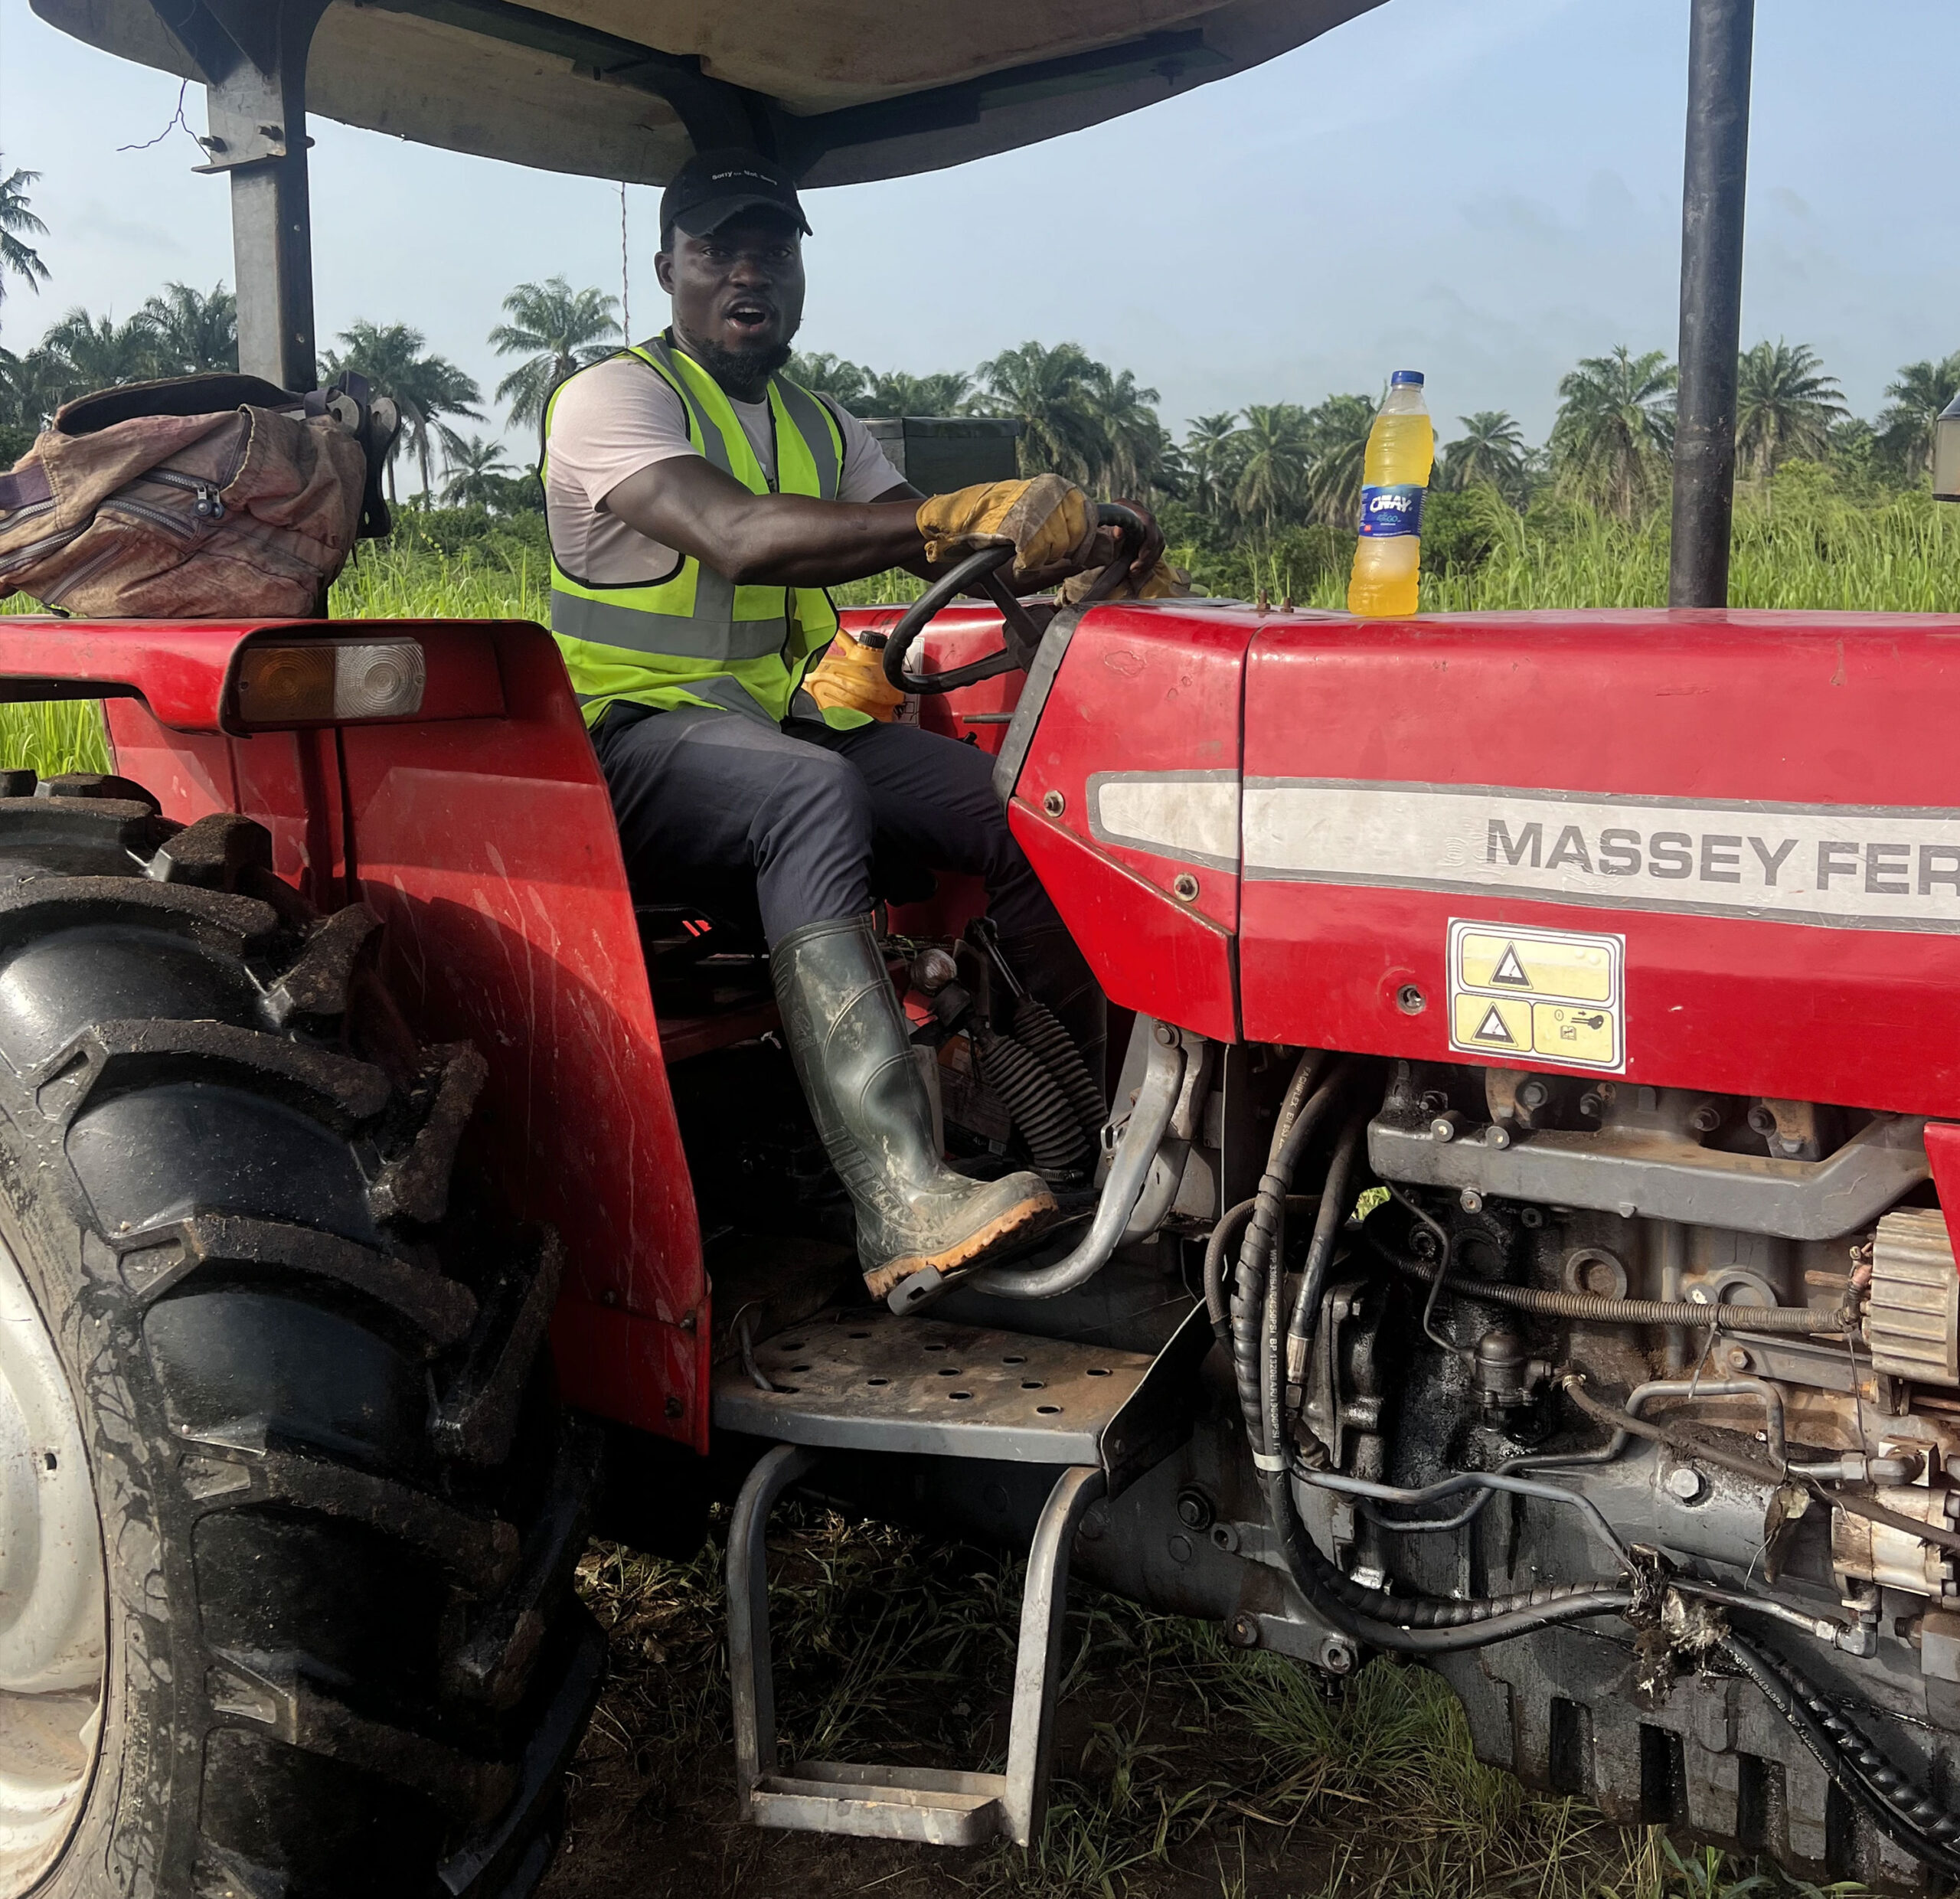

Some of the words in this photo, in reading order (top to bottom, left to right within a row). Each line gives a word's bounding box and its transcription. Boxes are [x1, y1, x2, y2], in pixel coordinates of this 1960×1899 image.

[1486, 819, 1799, 887] MASSEY
[1817, 840, 1960, 897] FER
[1269, 1338, 1278, 1352] BP
